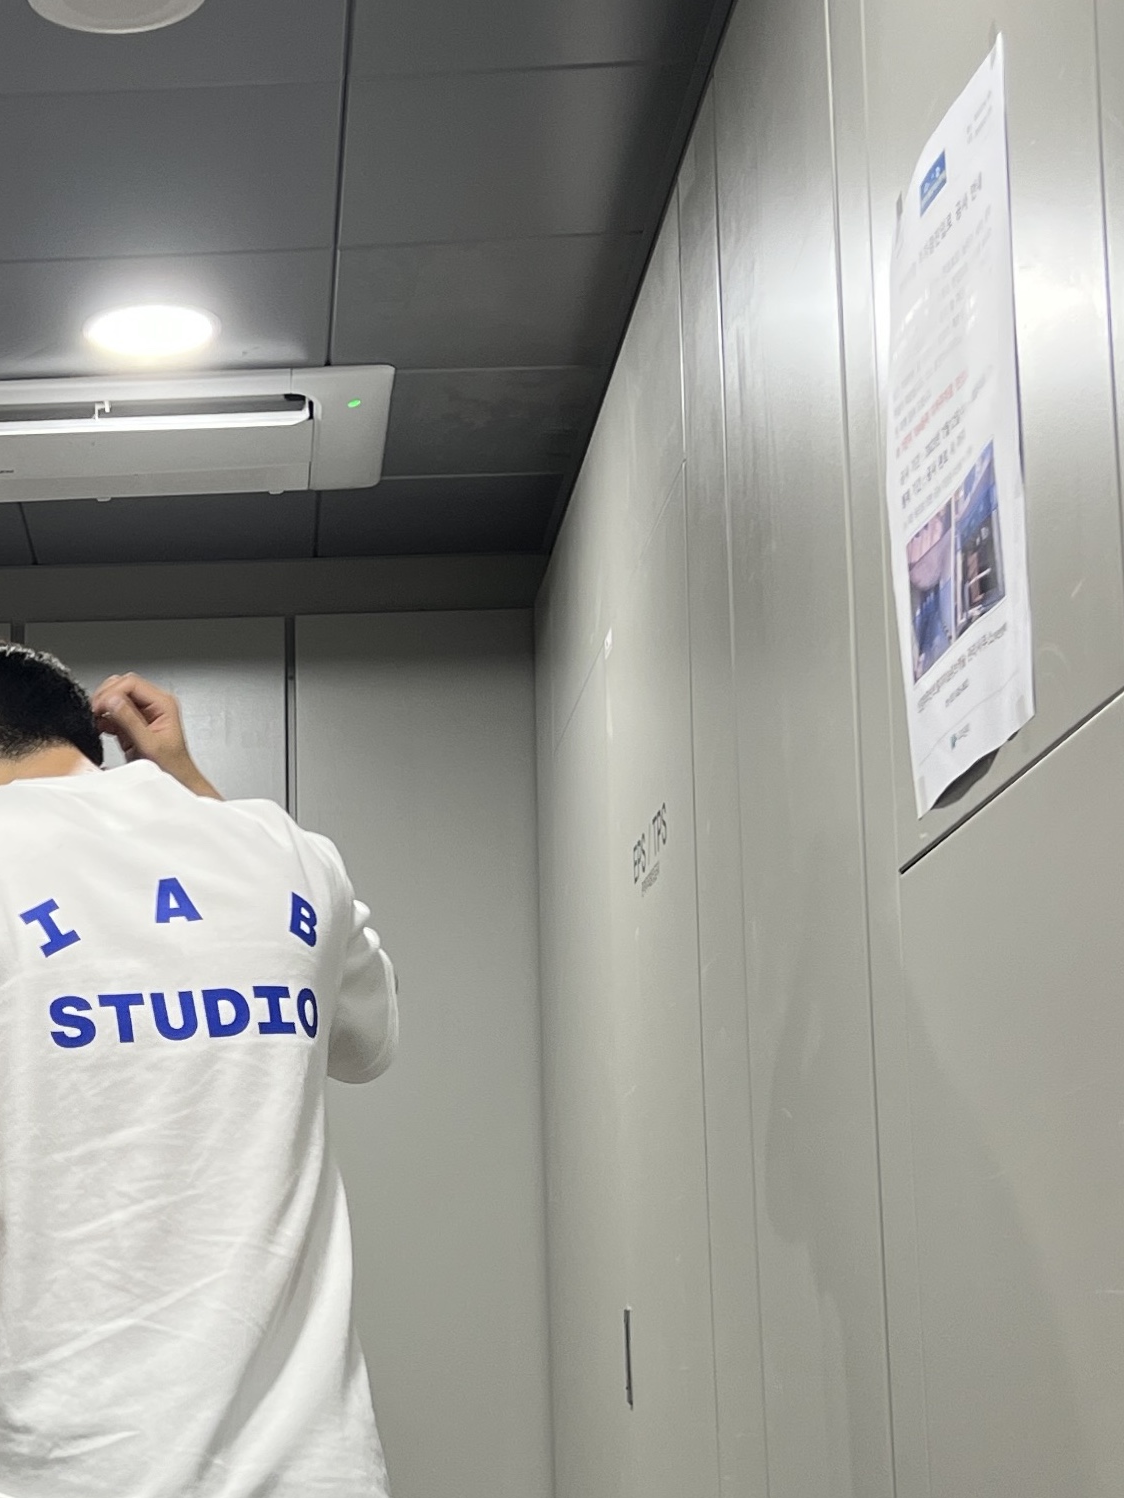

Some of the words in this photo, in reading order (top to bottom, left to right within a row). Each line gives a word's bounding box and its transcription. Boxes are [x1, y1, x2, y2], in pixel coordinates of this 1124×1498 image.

[633, 832, 647, 885] EPS
[652, 801, 667, 857] TPS
[49, 985, 319, 1049] STUDIO
